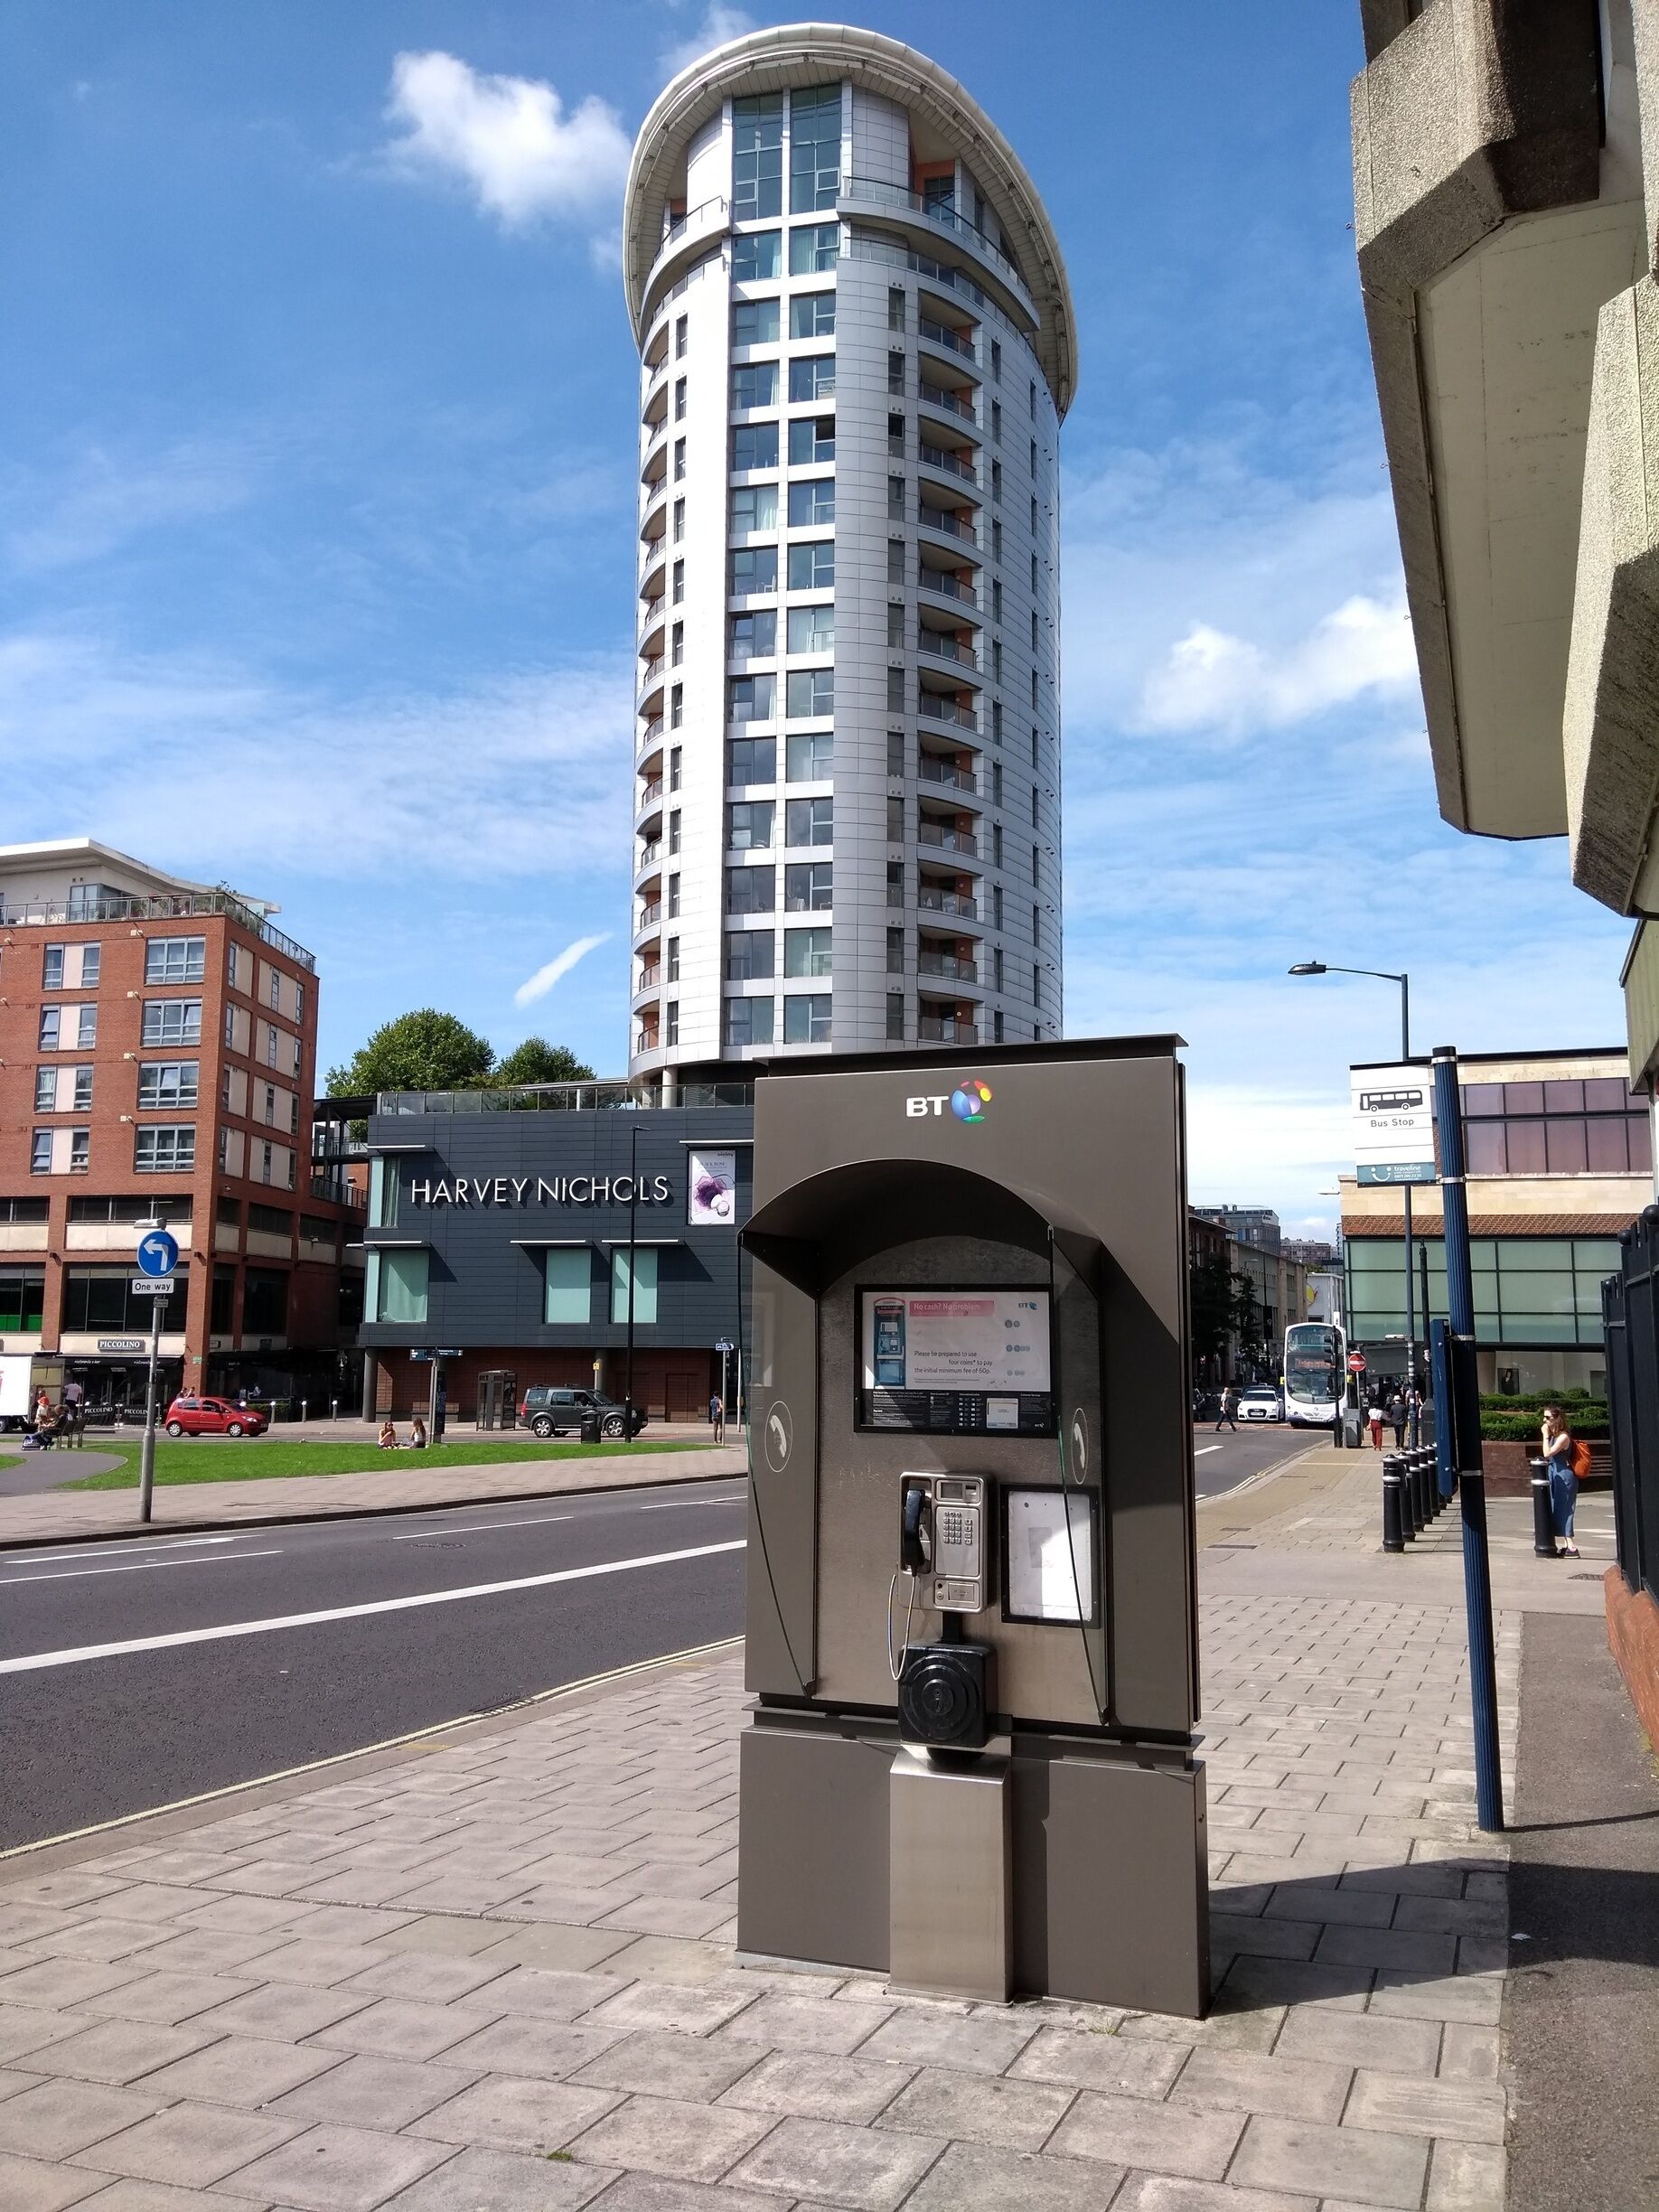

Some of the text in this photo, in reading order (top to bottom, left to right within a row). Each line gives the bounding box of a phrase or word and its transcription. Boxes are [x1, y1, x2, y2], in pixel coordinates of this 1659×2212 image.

[905, 1095, 950, 1118] BT
[1370, 1118, 1415, 1128] Bus Stop
[411, 1176, 669, 1204] HARVEY NICHOLS
[135, 1282, 171, 1291] One way
[914, 1302, 980, 1311] No cash? No problem
[99, 1340, 140, 1348] PICCOLINO
